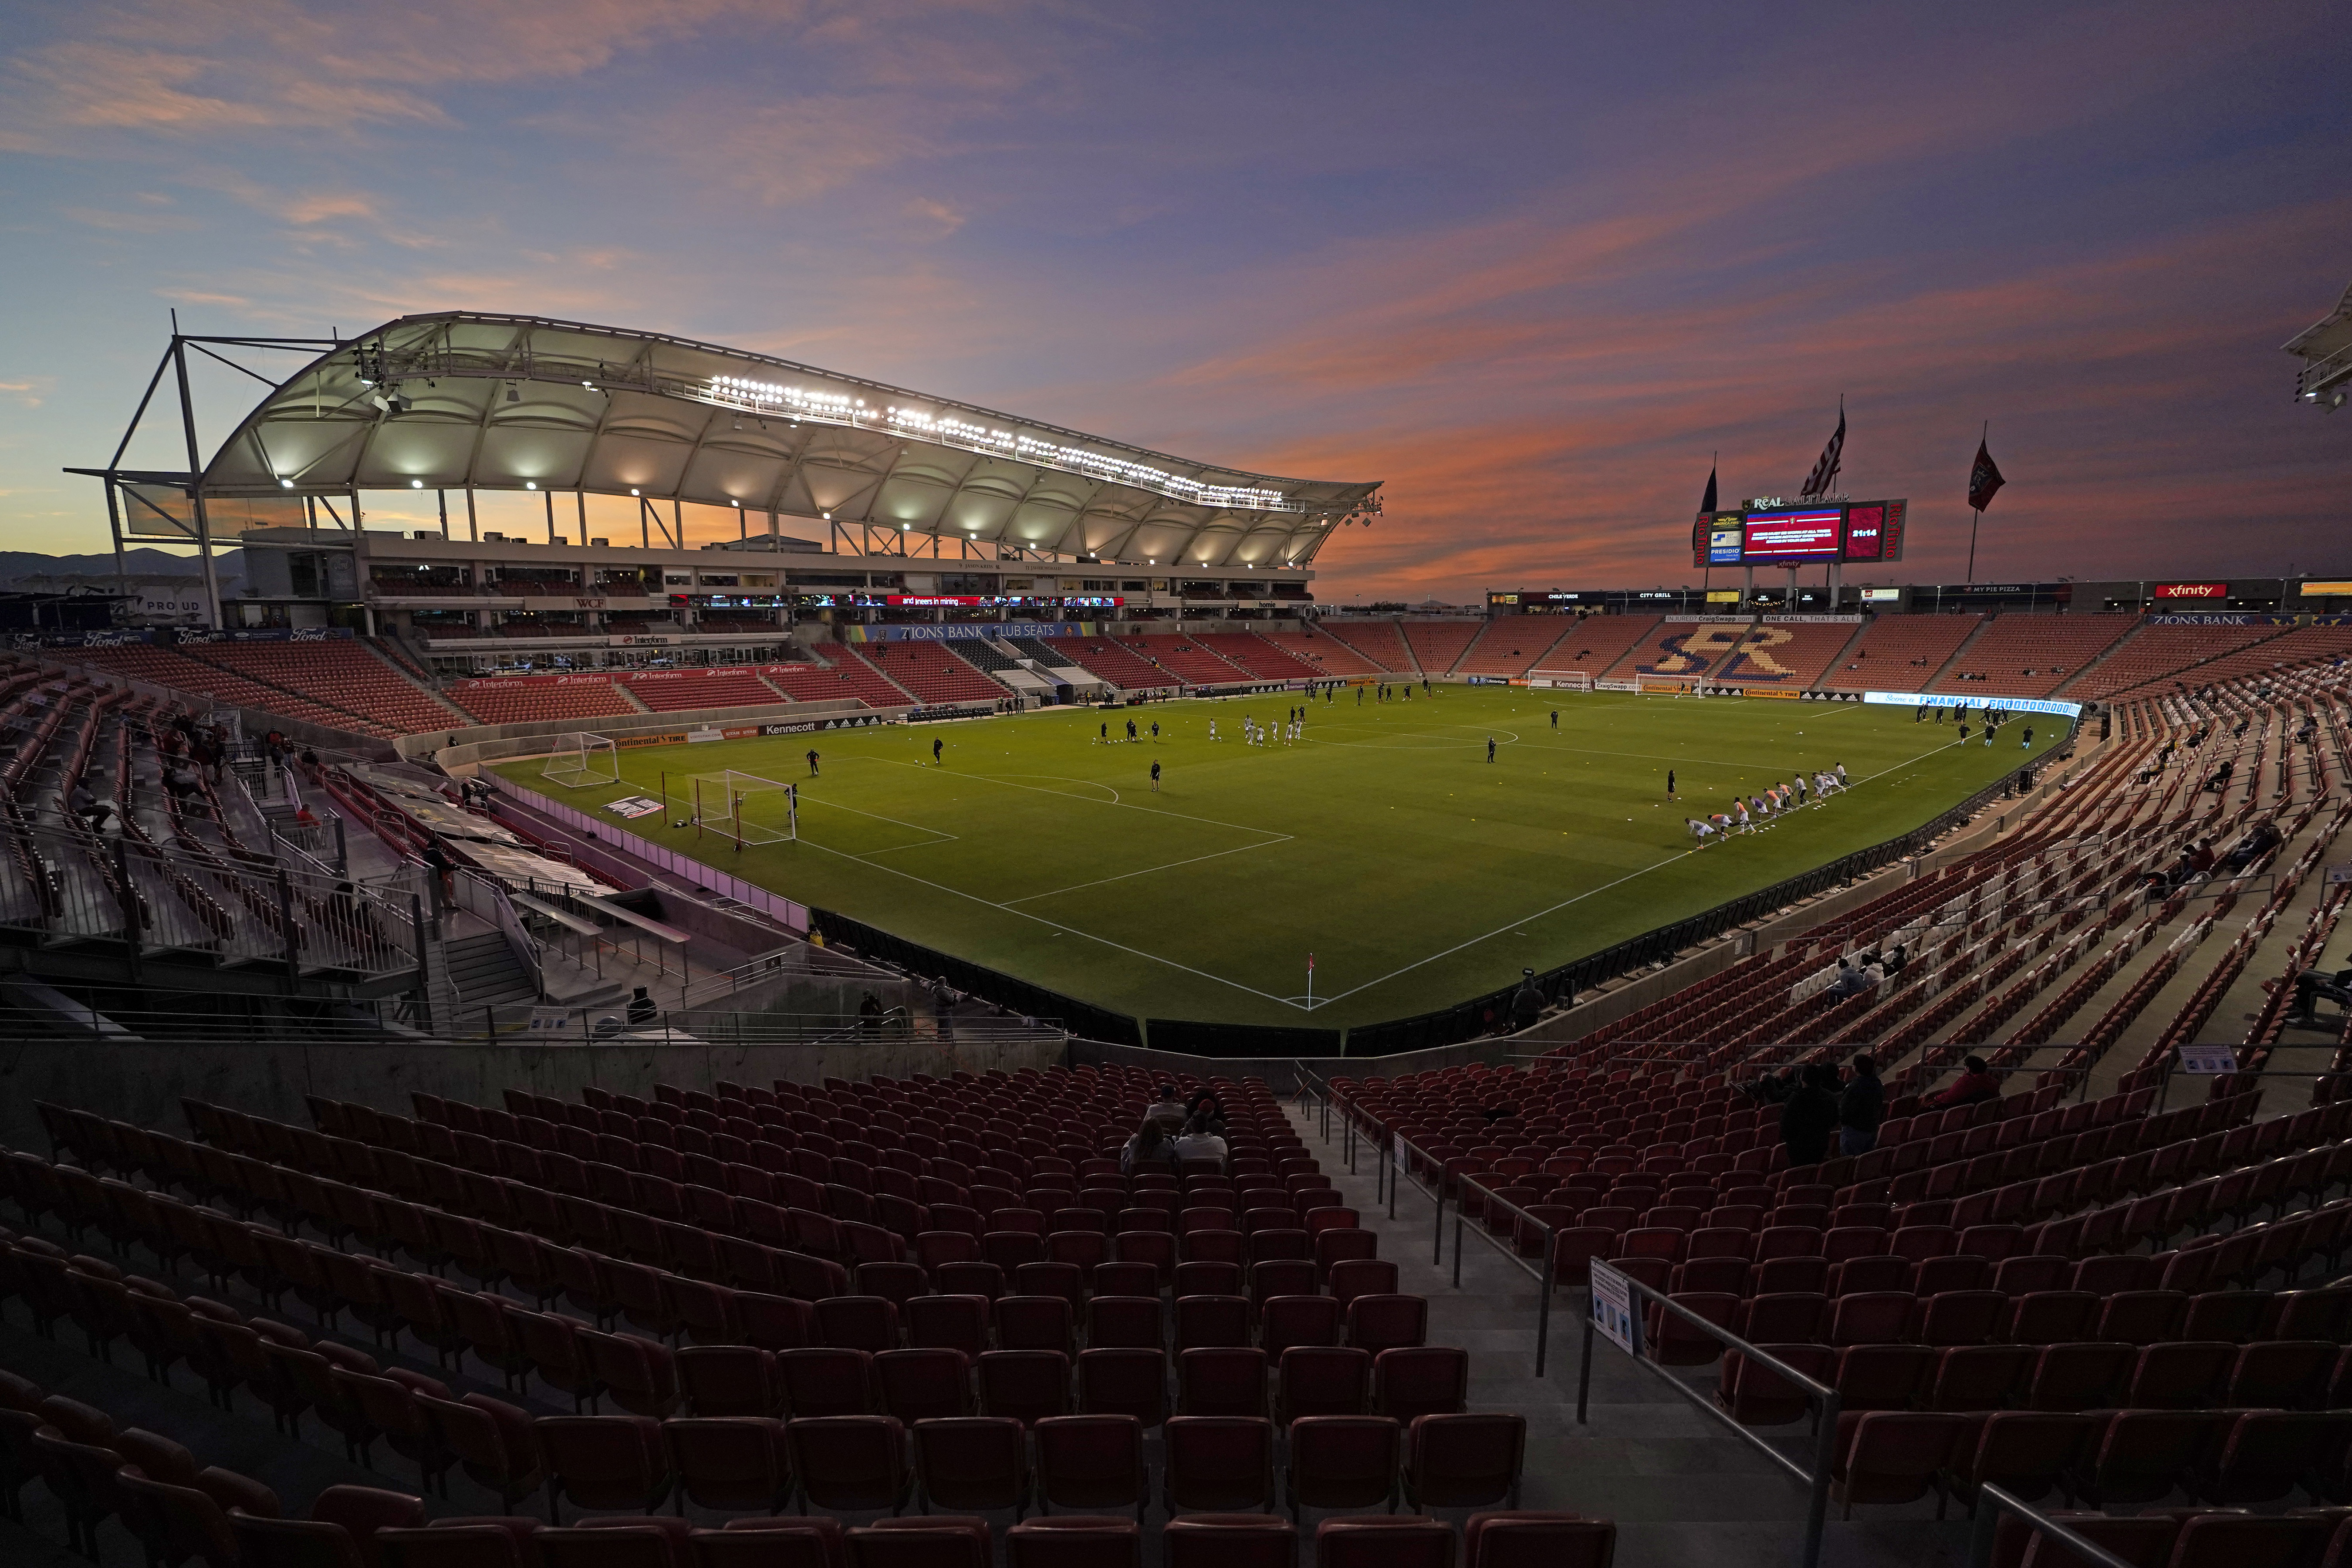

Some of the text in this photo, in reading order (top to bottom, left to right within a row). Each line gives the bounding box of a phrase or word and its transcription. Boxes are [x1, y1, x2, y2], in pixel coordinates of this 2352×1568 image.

[1816, 493, 1849, 504] LAKE
[1852, 529, 1877, 537] 21:14
[2168, 585, 2213, 597] xfinity
[576, 598, 604, 608] WCF
[940, 598, 958, 606] mining
[2154, 616, 2245, 625] ZIONS BANK
[178, 630, 211, 644] Ford
[290, 628, 328, 641] Ford
[900, 625, 1054, 639] ZIONS BANK CLUB SEATS
[84, 631, 123, 646] Ford
[482, 679, 523, 688] Interform
[570, 675, 607, 684] Interform
[1886, 694, 1907, 702] Score
[1919, 696, 1982, 707] FINANCIAL
[766, 722, 815, 735] Kennecott
[615, 736, 659, 749] Continental
